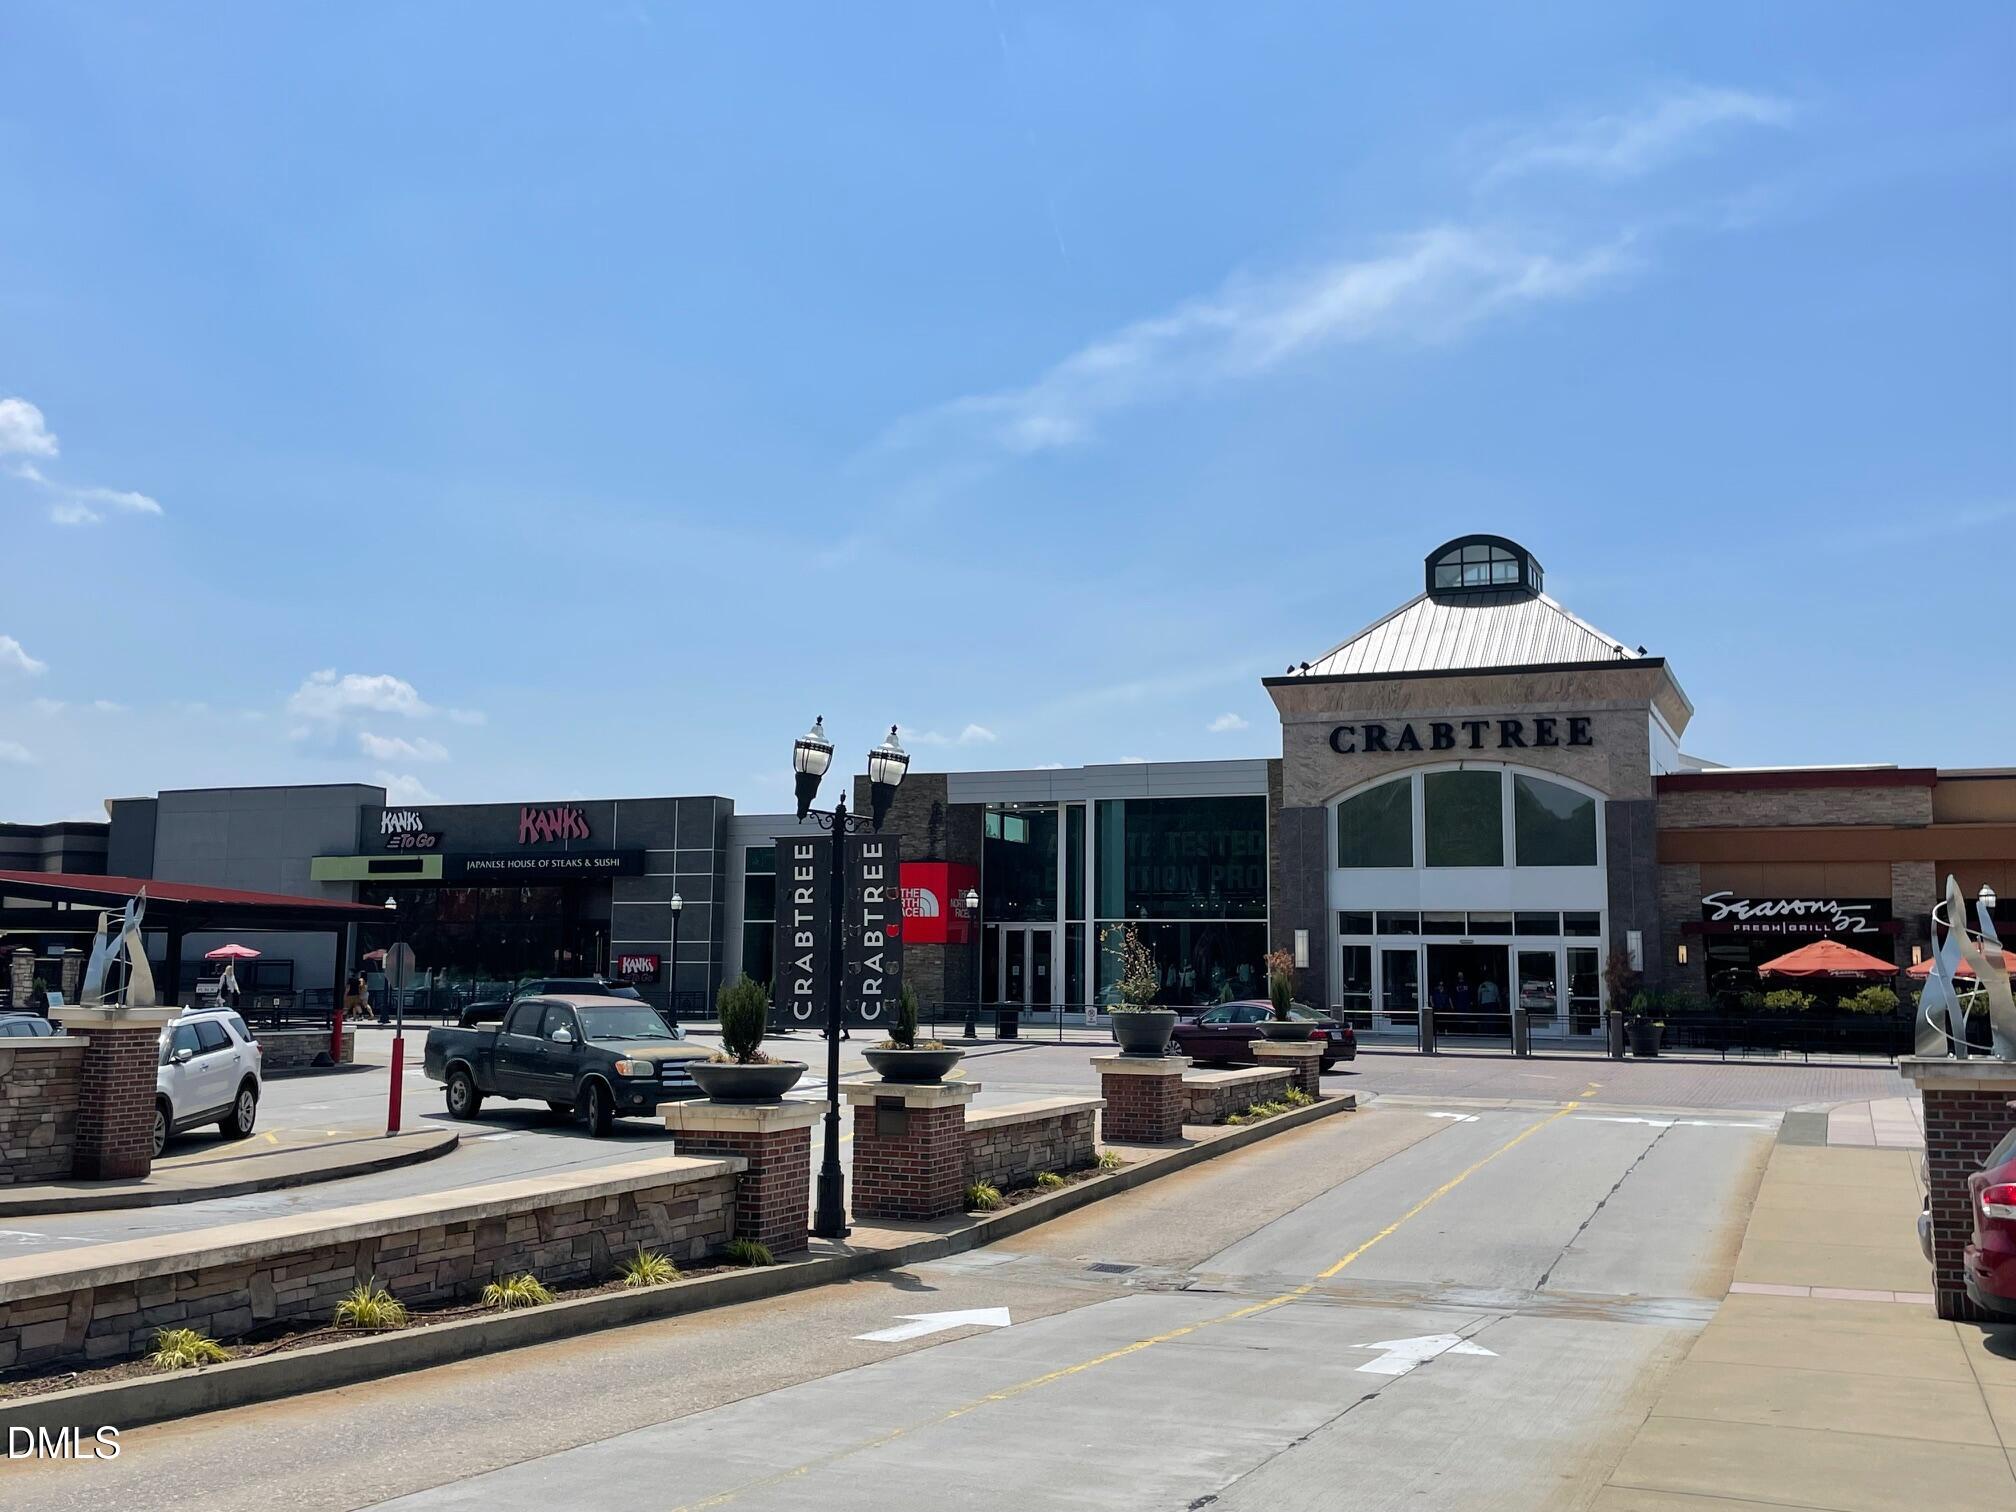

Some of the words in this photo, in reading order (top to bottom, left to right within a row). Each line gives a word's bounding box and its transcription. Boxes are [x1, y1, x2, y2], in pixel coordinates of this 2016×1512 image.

[1329, 717, 1593, 754] CRABTREE
[401, 833, 415, 848] To
[416, 833, 436, 848] Go
[466, 860, 505, 871] JAPANESE
[507, 859, 536, 869] HOUSE
[538, 859, 550, 868] OF
[552, 858, 582, 868] STEAKS
[584, 859, 592, 867] &
[594, 858, 620, 867] SUSHI
[901, 888, 920, 898] THE
[1701, 891, 1838, 920] Seasons
[1832, 905, 1879, 933] 52
[793, 844, 814, 1021] CRABTREE
[860, 842, 884, 1021] CRABTREE
[1733, 924, 1781, 932] FRESH
[1788, 924, 1831, 932] GRILL
